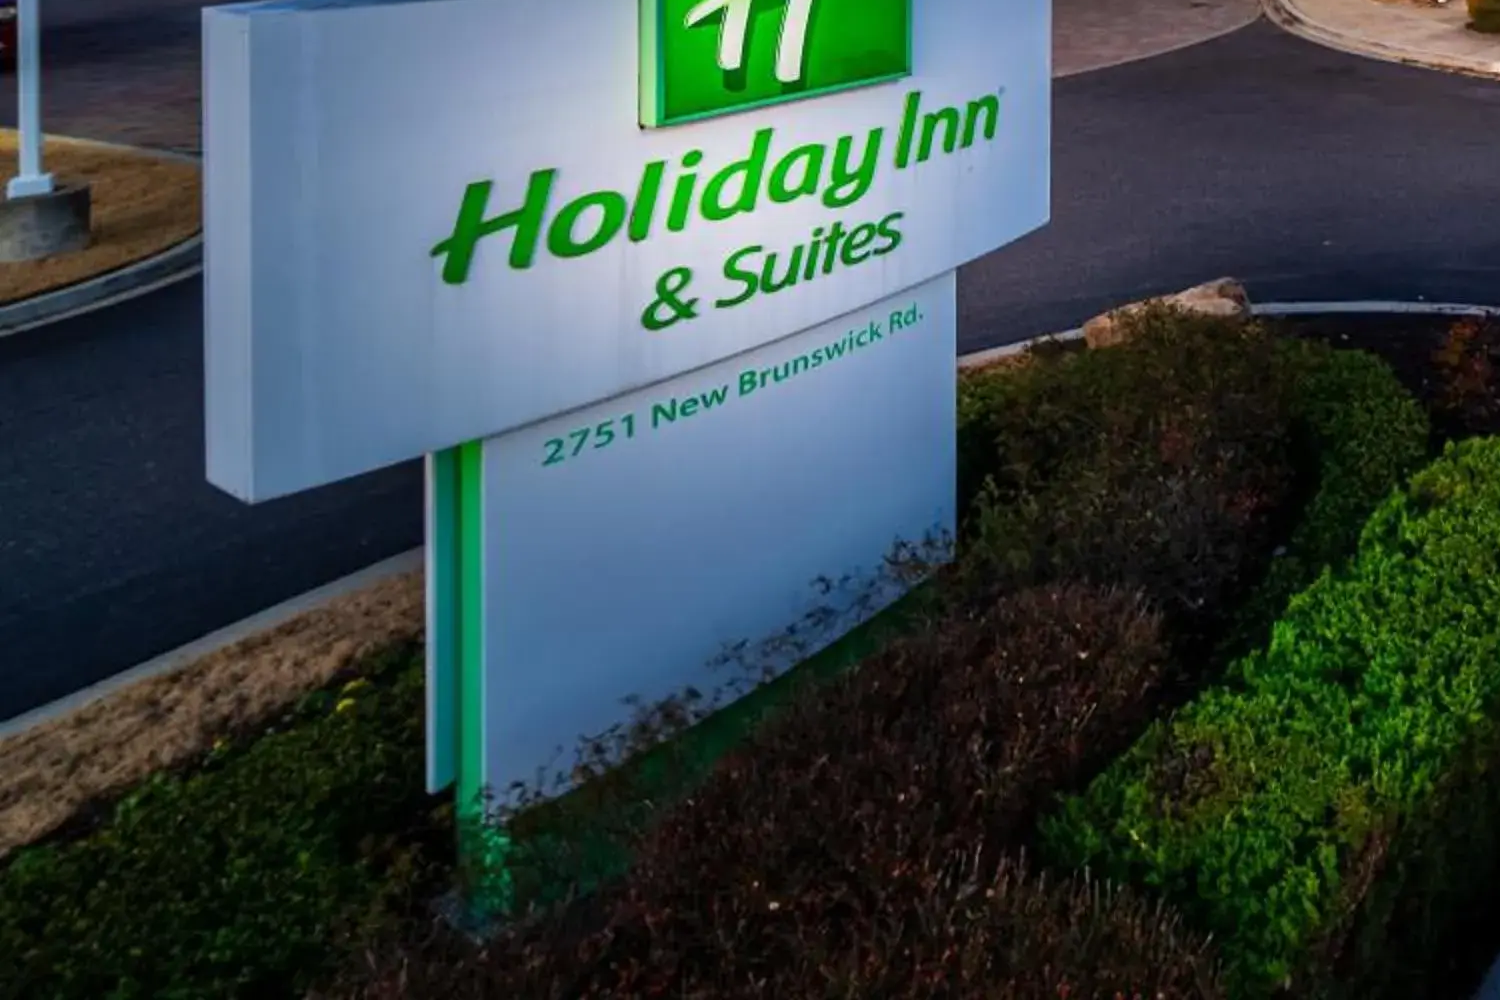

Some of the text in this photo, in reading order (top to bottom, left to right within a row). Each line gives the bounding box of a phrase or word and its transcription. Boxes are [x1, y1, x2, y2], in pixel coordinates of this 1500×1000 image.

[429, 91, 1000, 286] Holiday Inn
[640, 211, 904, 332] & Suites
[540, 301, 925, 467] 2751 New Brunswick Rd.
